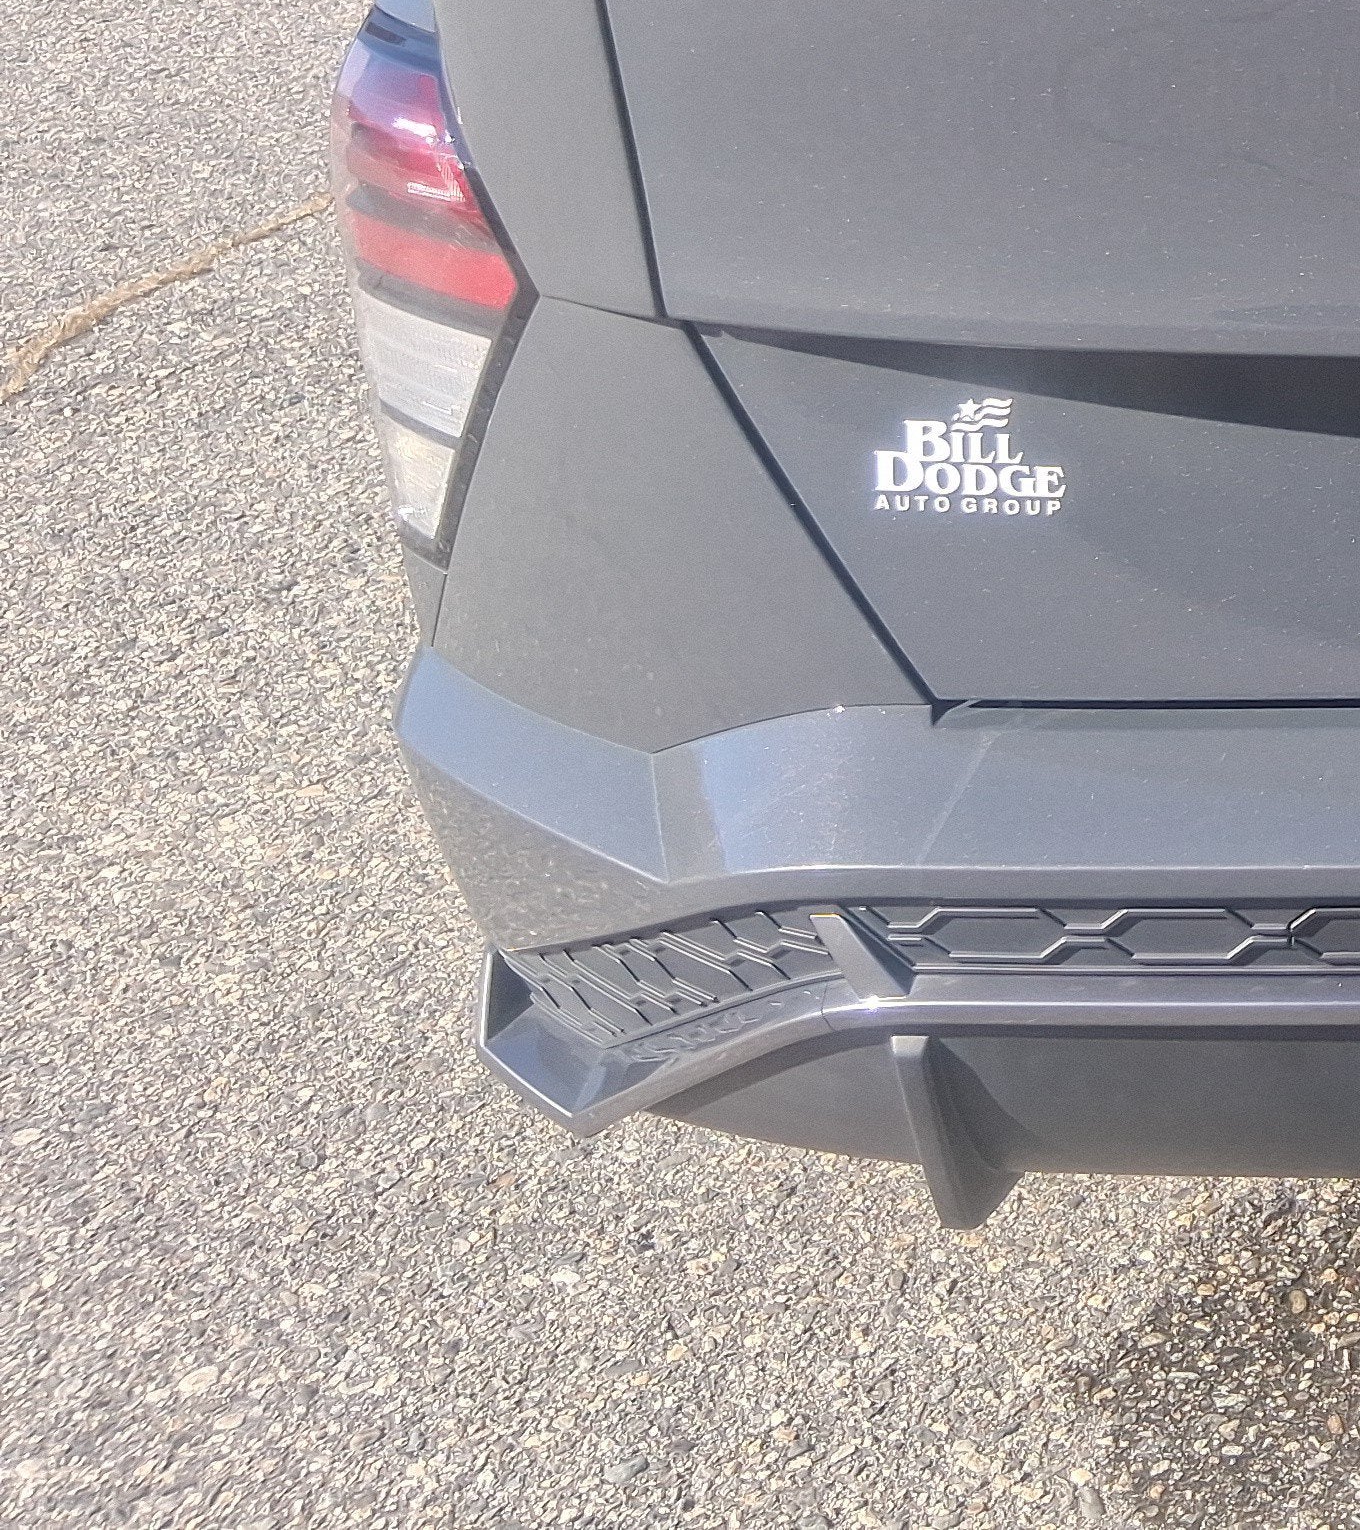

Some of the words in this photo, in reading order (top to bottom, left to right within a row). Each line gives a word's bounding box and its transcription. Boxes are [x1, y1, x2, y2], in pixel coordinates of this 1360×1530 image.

[903, 419, 1024, 464] BILL
[873, 450, 1067, 498] DODGE
[873, 495, 951, 513] AUTO
[960, 498, 1062, 516] GROUP
